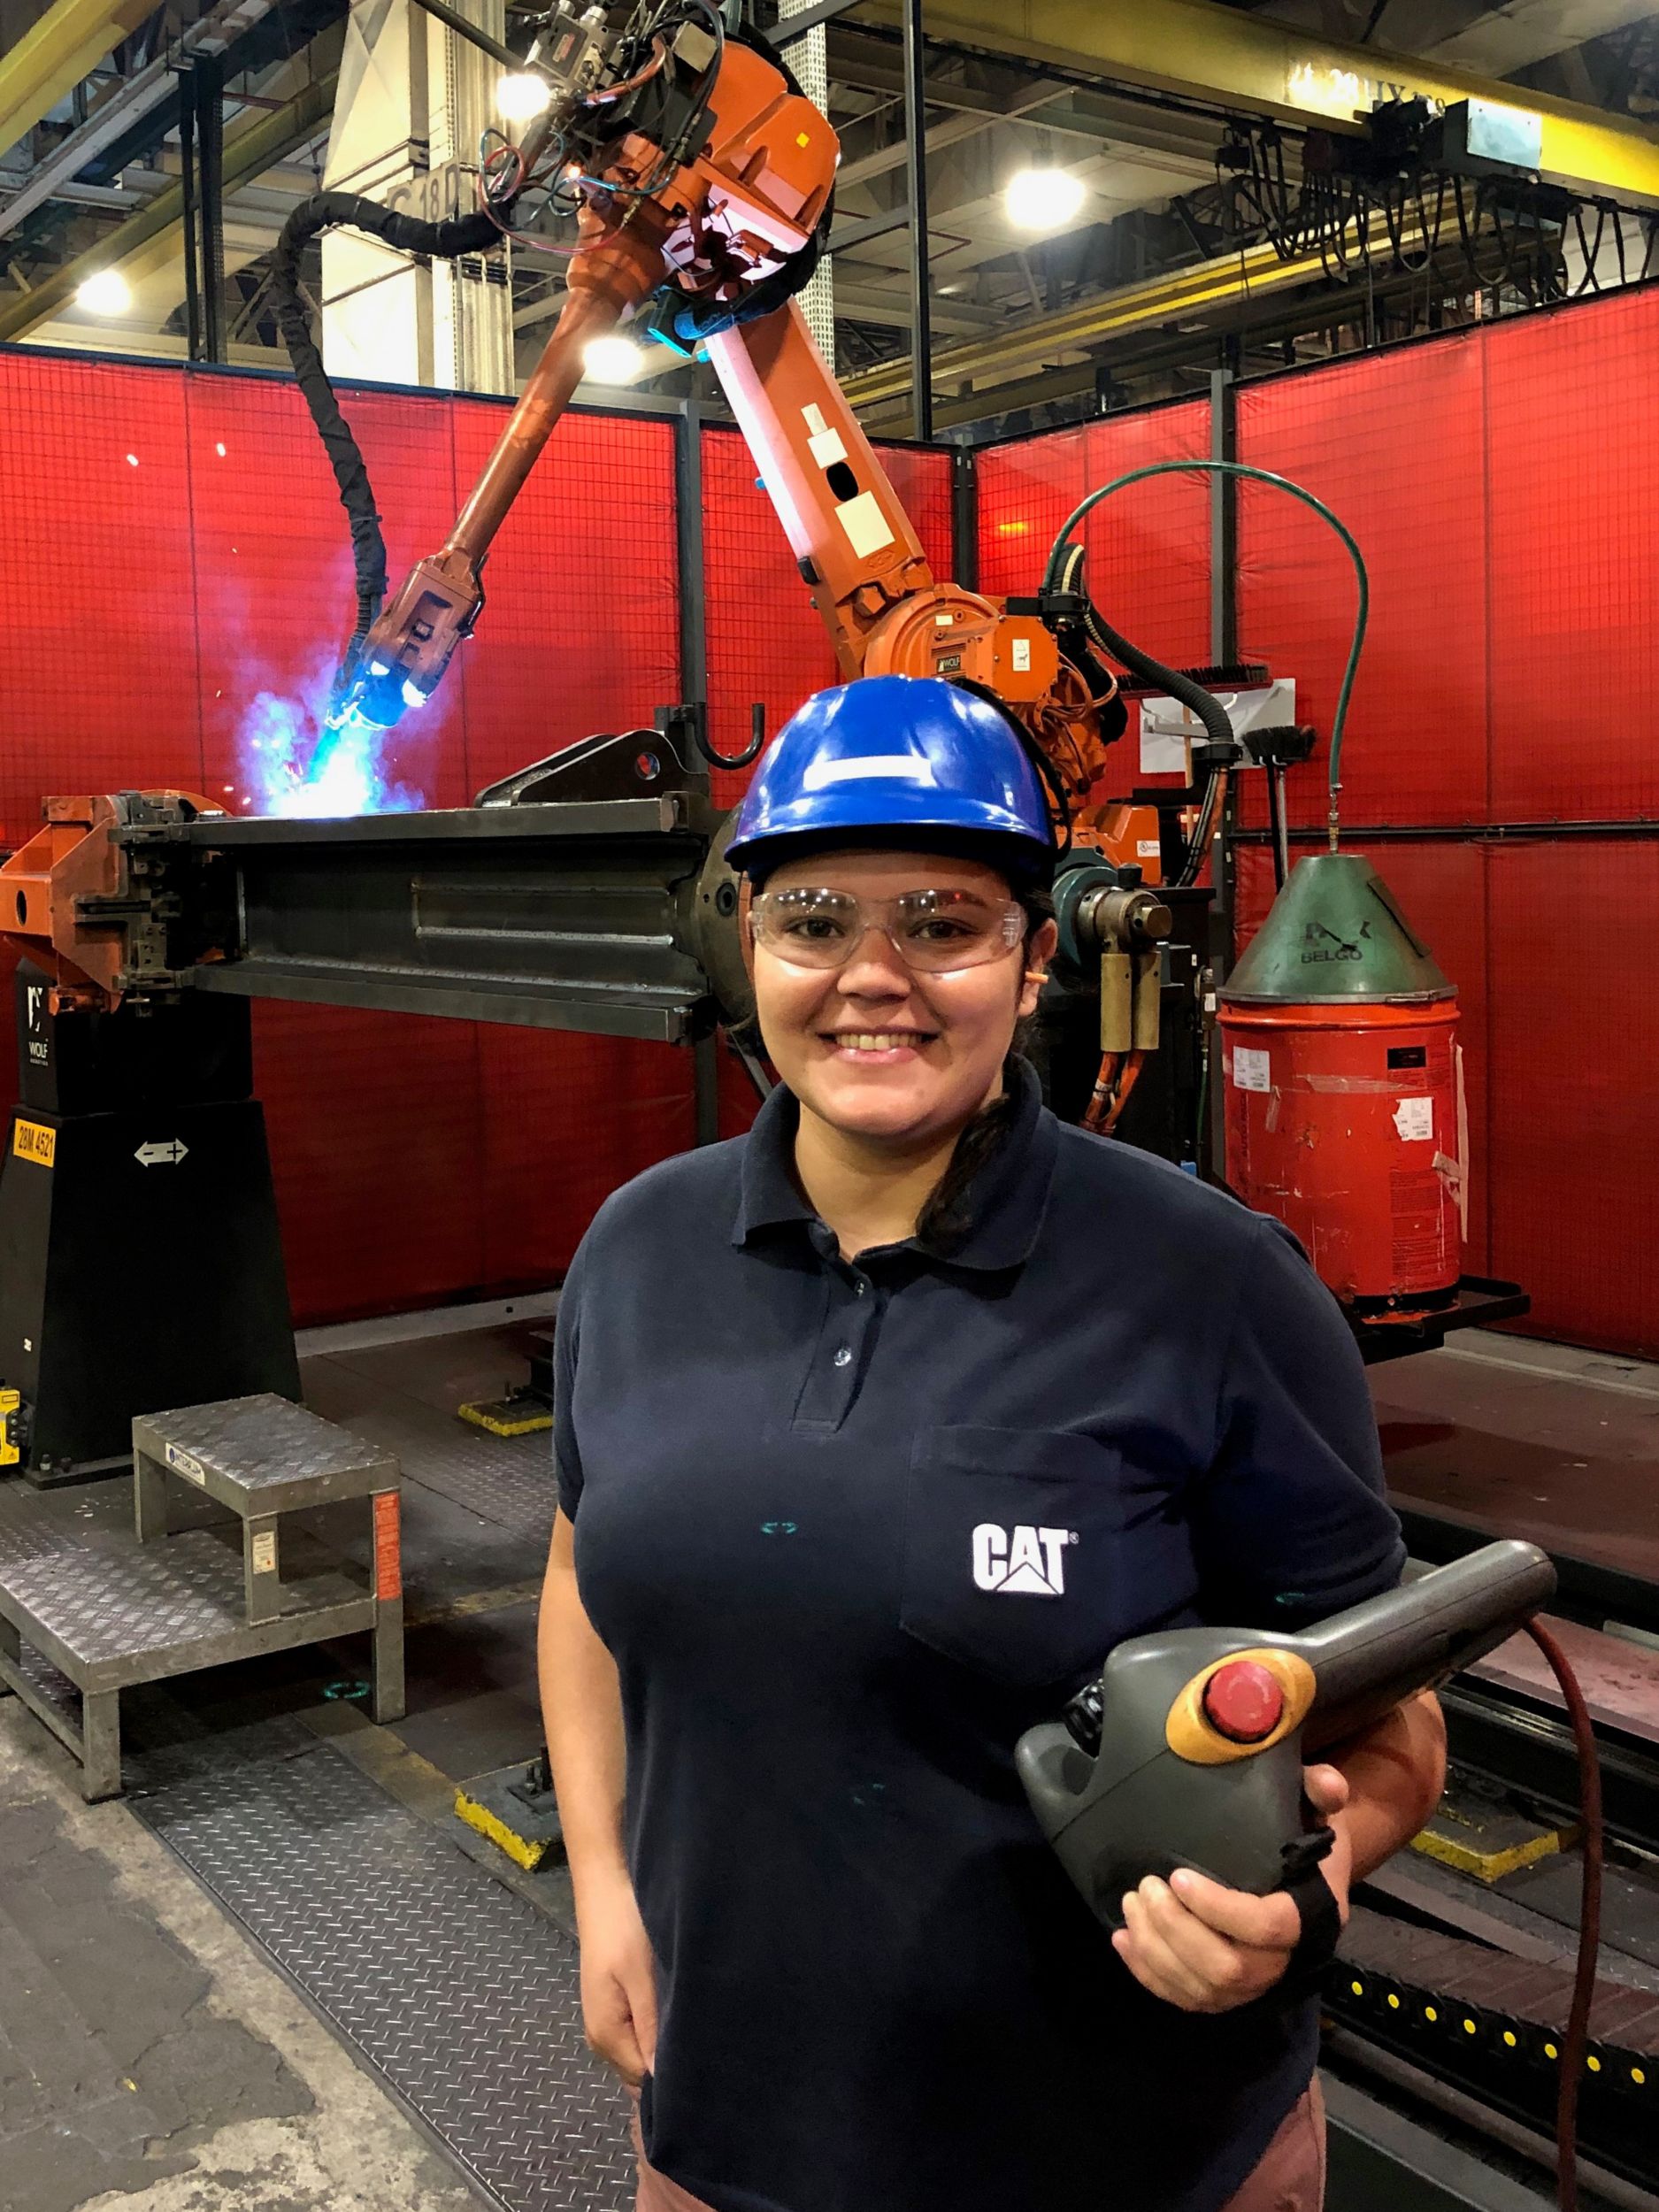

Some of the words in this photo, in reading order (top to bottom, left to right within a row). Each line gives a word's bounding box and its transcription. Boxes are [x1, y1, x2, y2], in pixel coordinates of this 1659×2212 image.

[943, 657, 960, 667] WOLF
[28, 1041, 48, 1058] WOLF
[35, 1132, 53, 1158] 4521
[972, 1523, 1069, 1594] CAT
